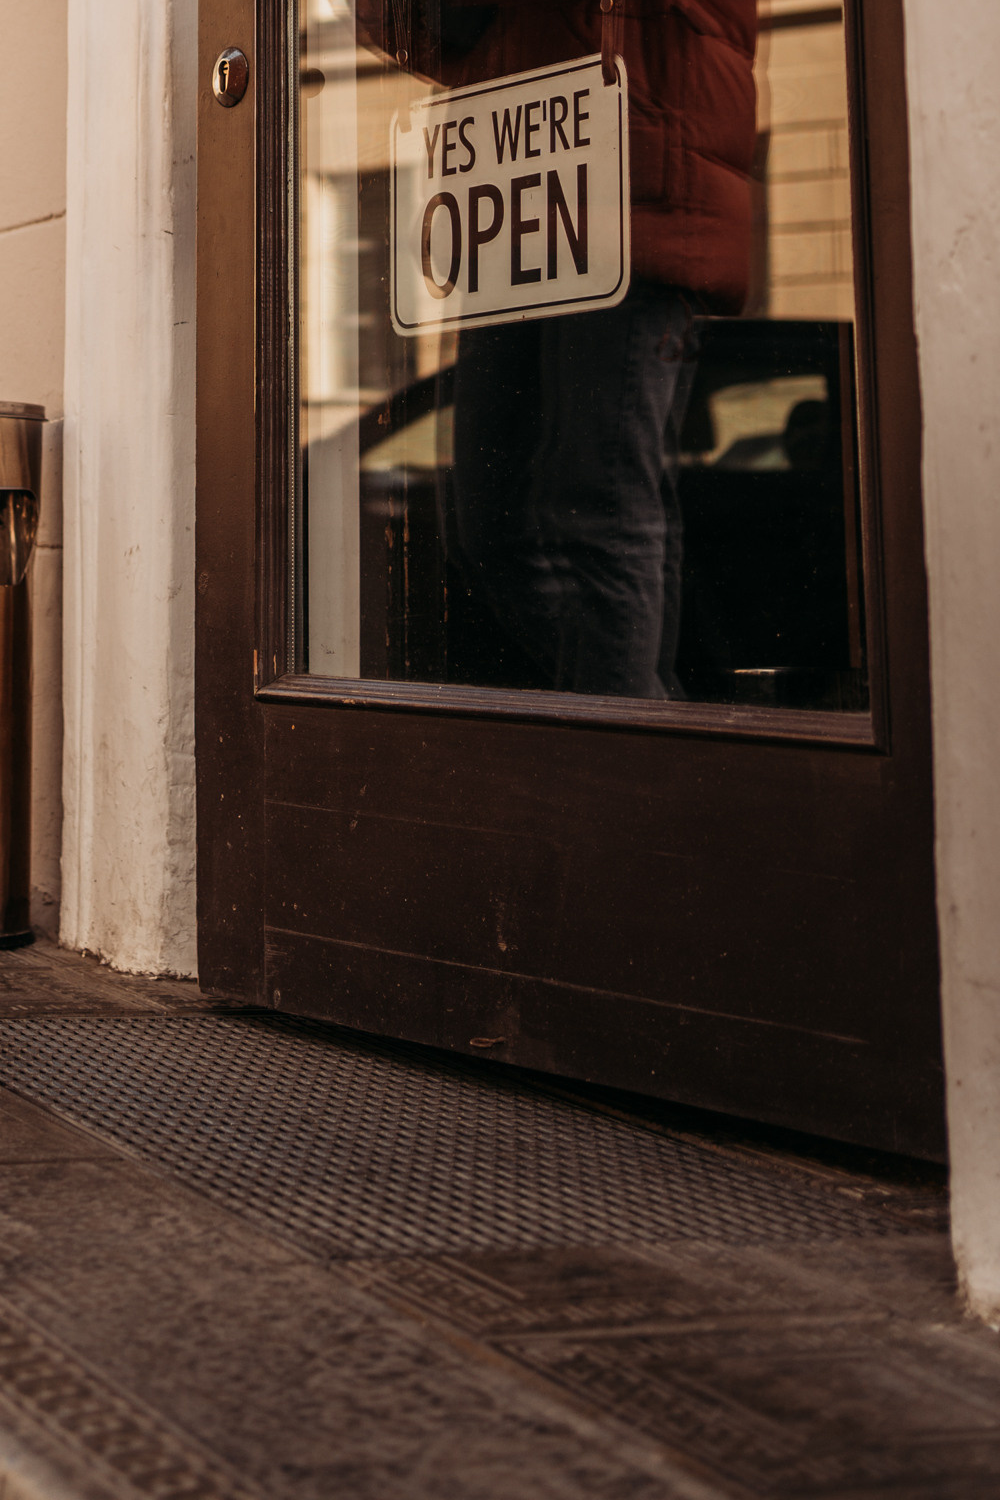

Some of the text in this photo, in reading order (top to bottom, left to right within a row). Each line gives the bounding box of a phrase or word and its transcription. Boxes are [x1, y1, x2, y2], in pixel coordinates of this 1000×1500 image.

[422, 88, 591, 179] YES WE'RE
[420, 162, 589, 300] OPEN
